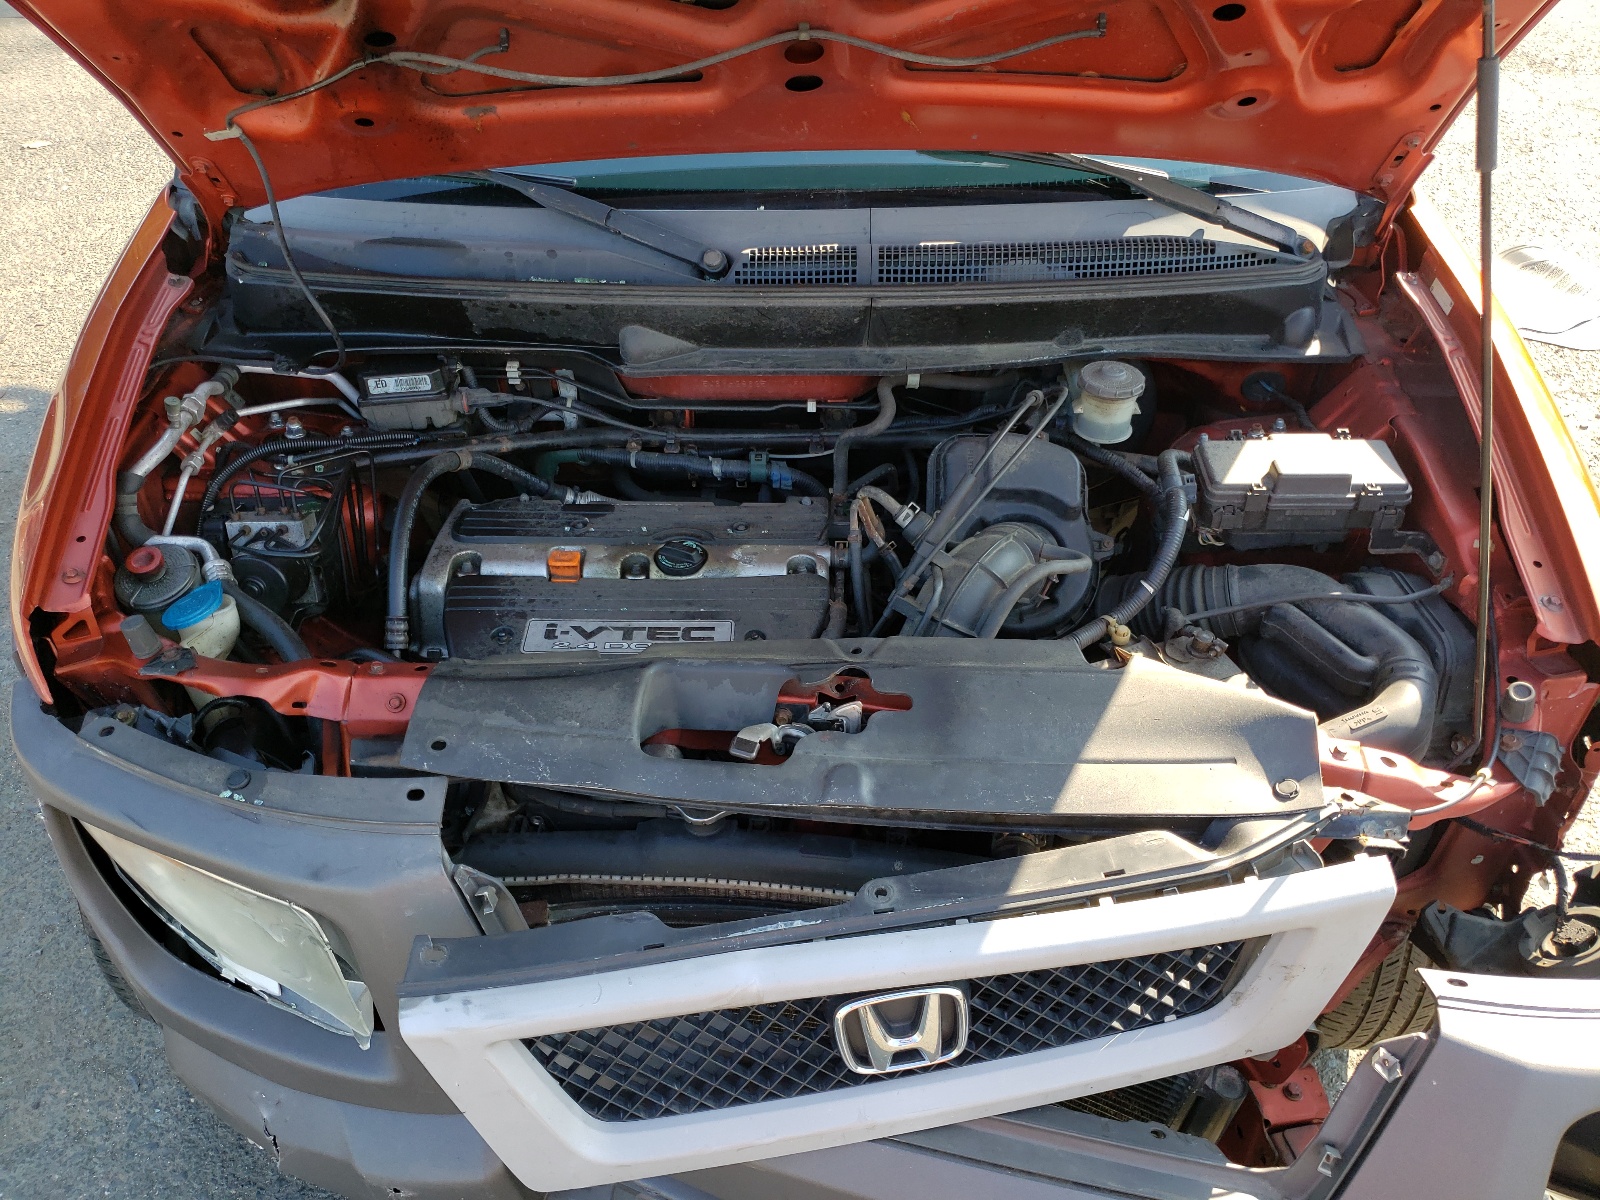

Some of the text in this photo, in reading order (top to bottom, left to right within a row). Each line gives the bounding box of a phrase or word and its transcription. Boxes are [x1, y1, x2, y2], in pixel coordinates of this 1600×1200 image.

[543, 623, 716, 642] i-VTEC
[551, 641, 653, 650] 2.4 DO
